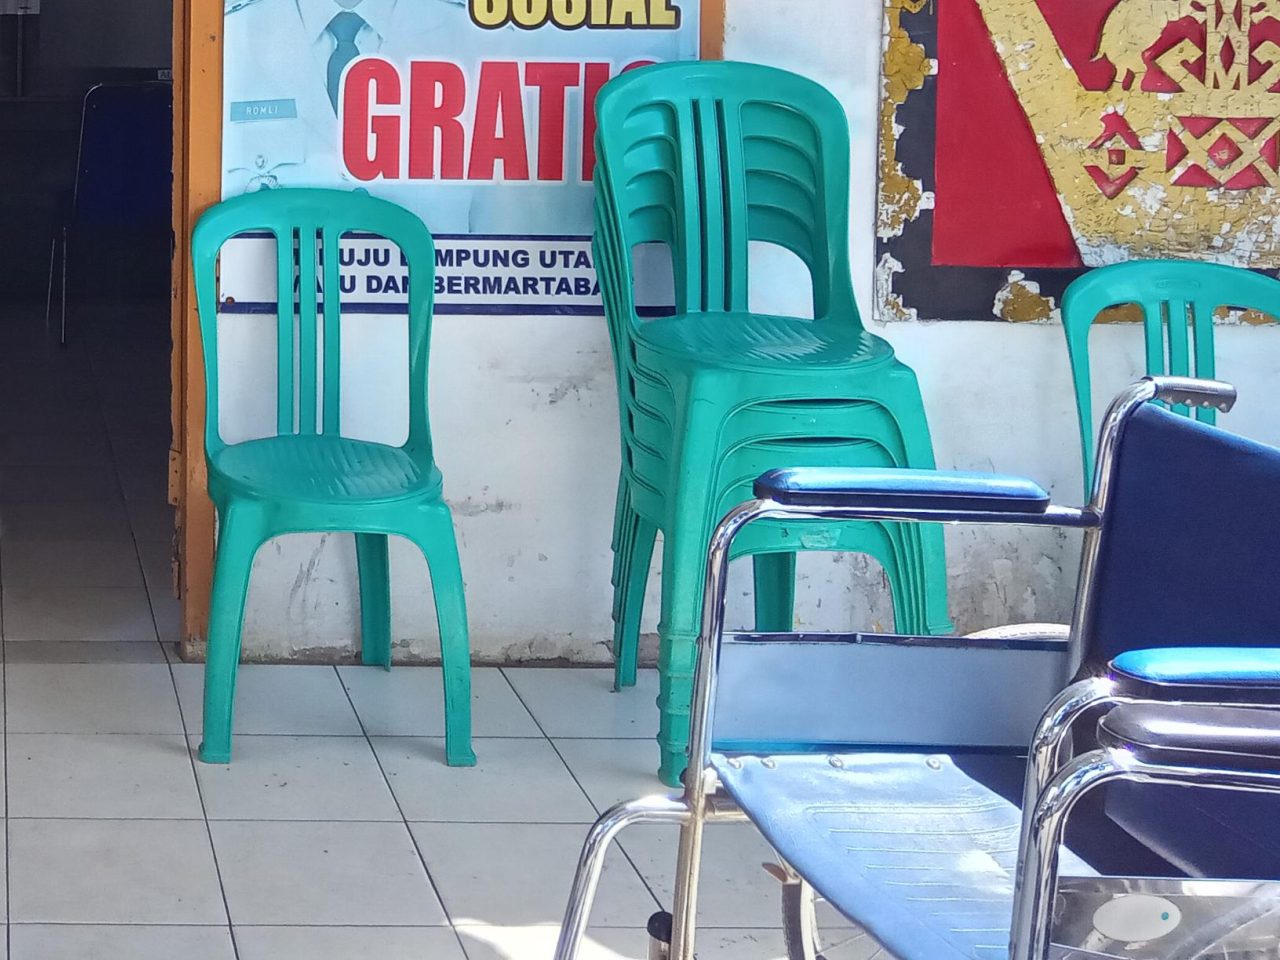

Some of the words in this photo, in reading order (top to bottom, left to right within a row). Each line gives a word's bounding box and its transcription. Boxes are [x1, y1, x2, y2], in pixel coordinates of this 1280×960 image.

[342, 57, 658, 182] GRATI
[400, 247, 530, 268] LMPUNG
[539, 250, 597, 269] UTA
[434, 276, 601, 296] BERMARTAB
